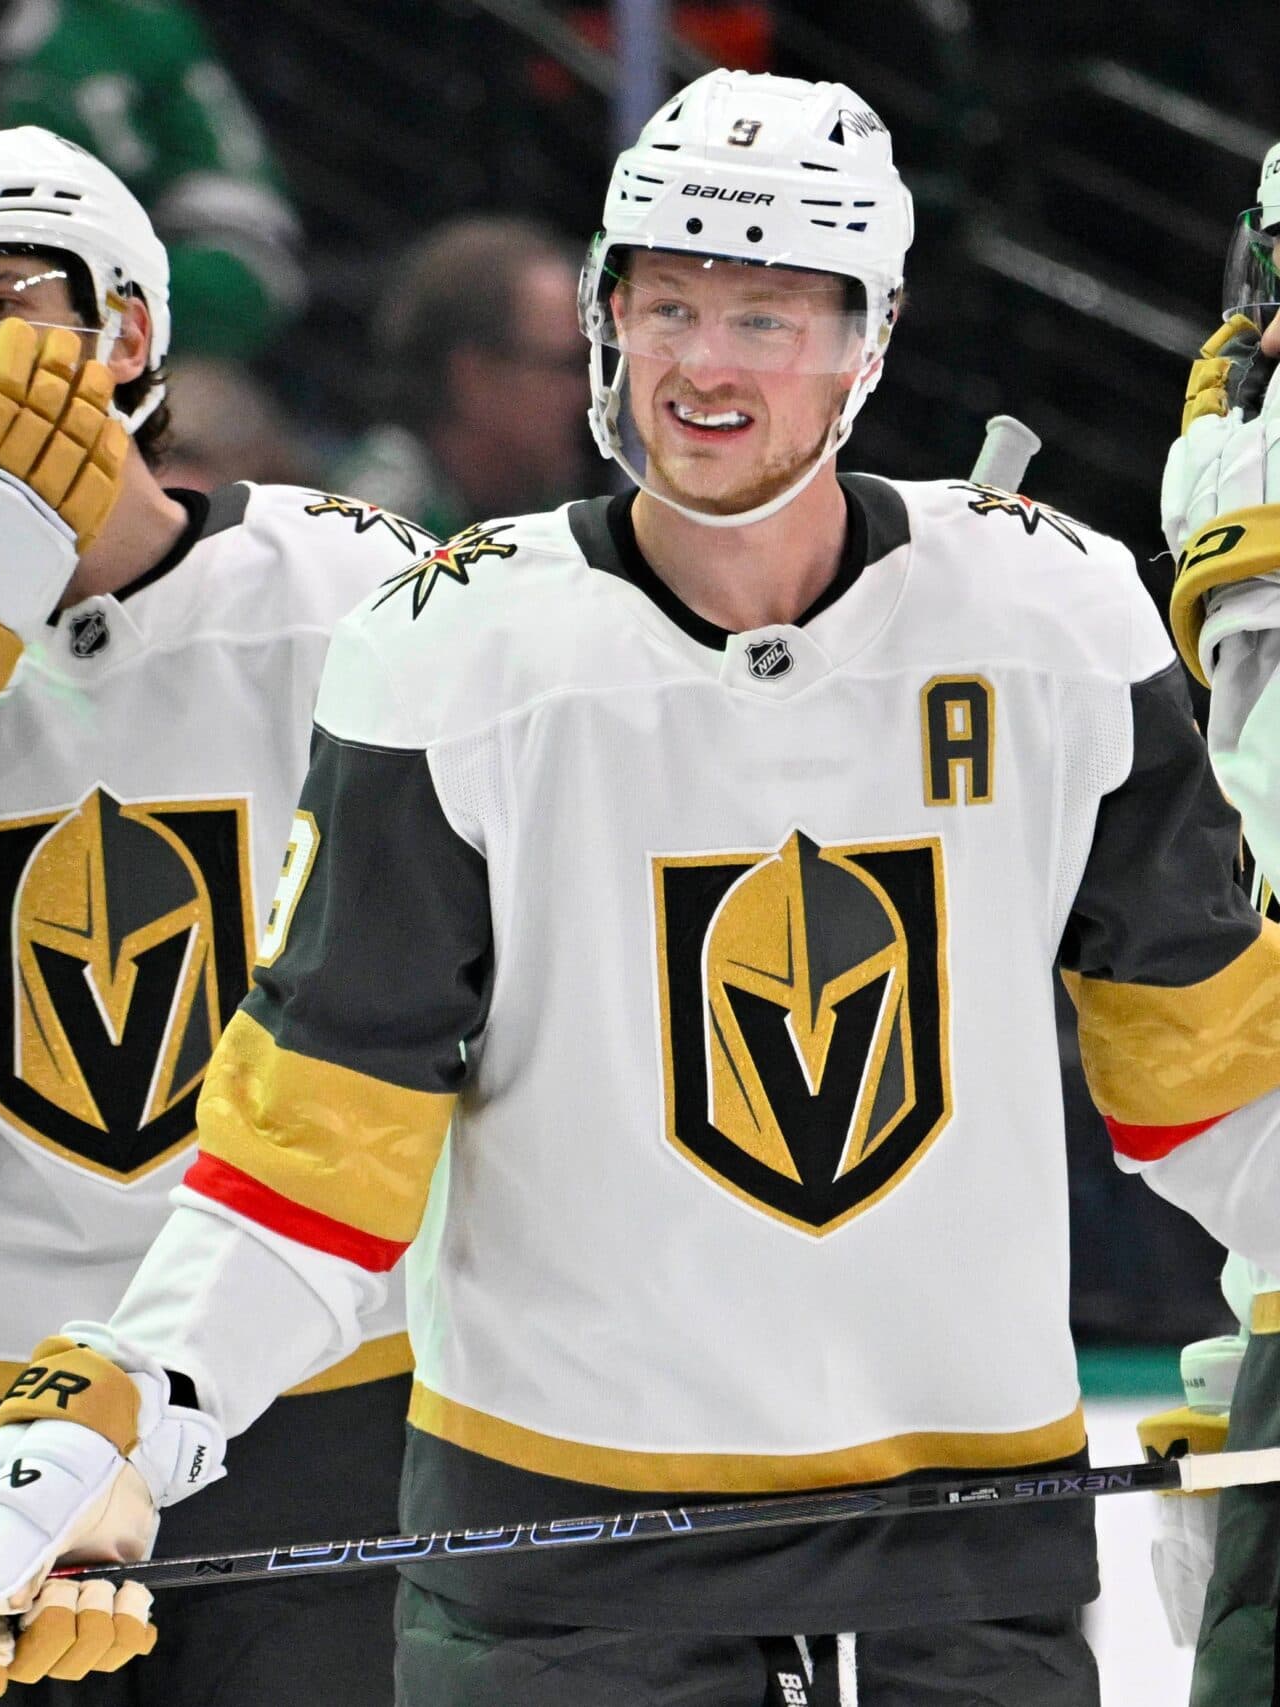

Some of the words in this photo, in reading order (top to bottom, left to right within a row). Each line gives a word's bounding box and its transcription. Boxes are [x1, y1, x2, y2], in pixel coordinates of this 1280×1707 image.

[727, 118, 763, 147] 9
[920, 674, 995, 807] A
[187, 1445, 206, 1483] MACH
[1013, 1472, 1133, 1498] NEXUS
